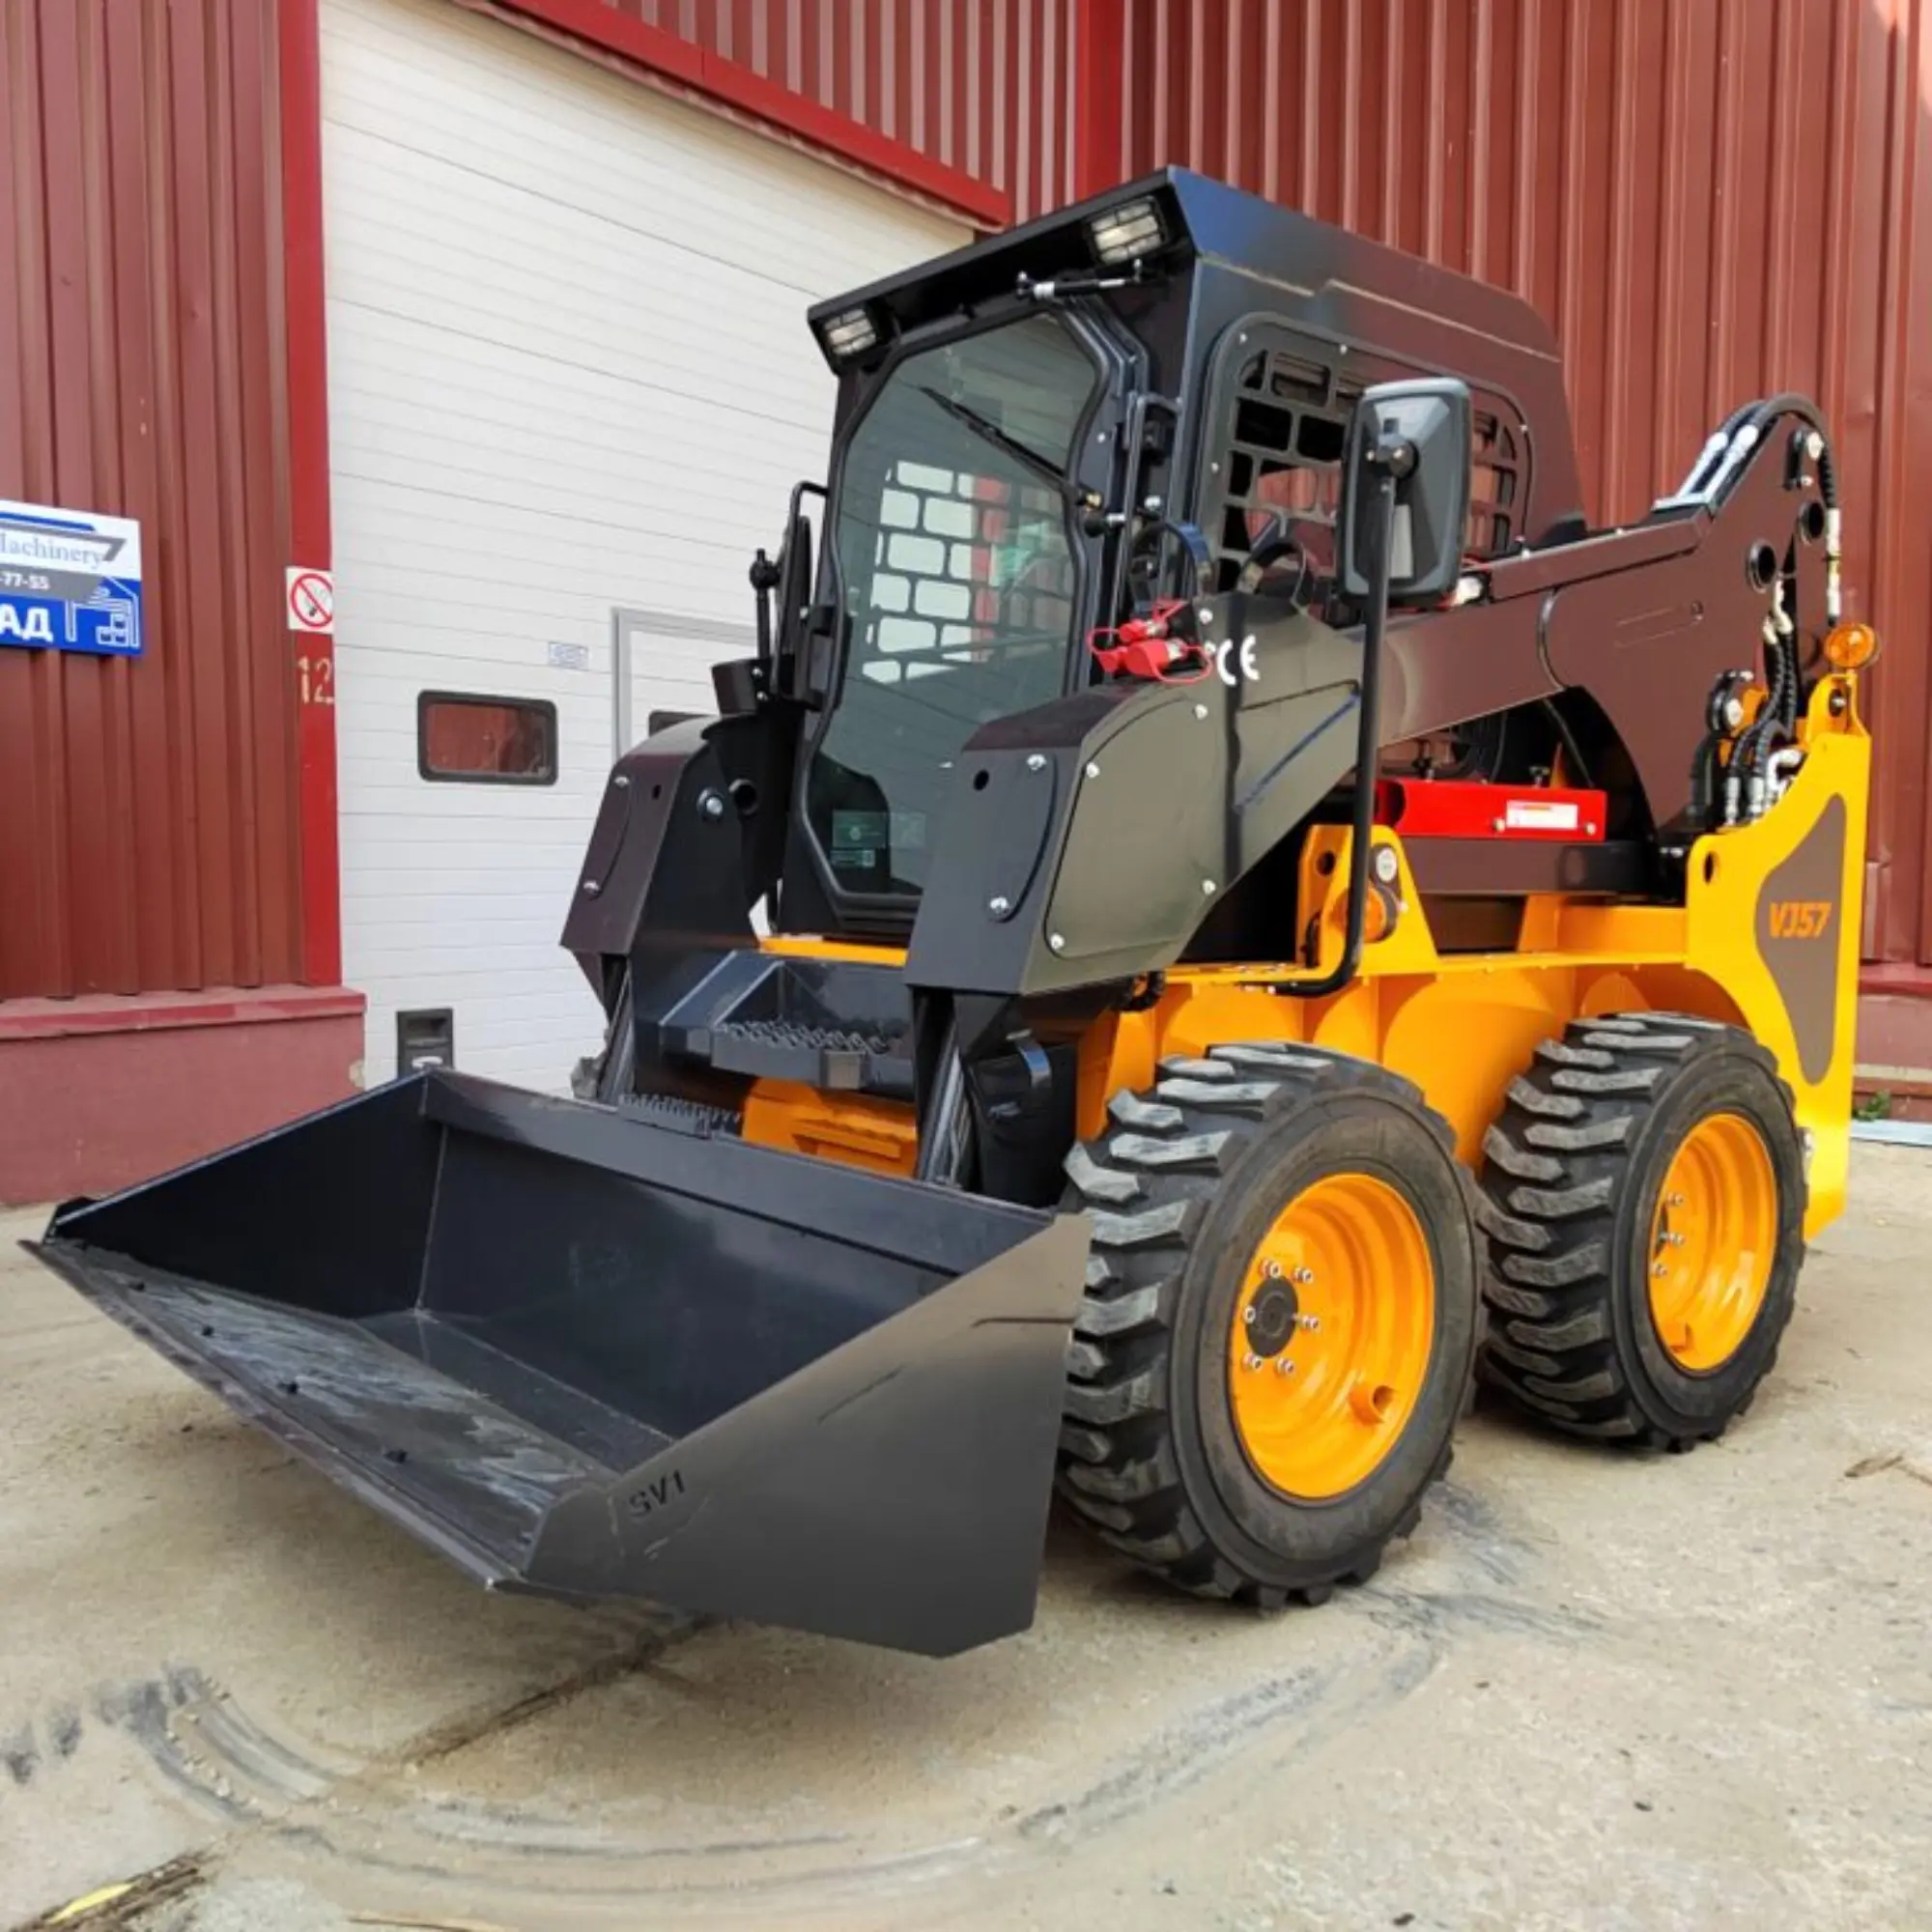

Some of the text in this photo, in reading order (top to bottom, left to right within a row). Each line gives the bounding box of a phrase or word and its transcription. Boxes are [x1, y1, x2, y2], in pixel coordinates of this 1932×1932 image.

[0, 531, 99, 569] achinery
[298, 656, 334, 705] 12
[1217, 634, 1260, 686] CE
[629, 1468, 685, 1518] SV1
